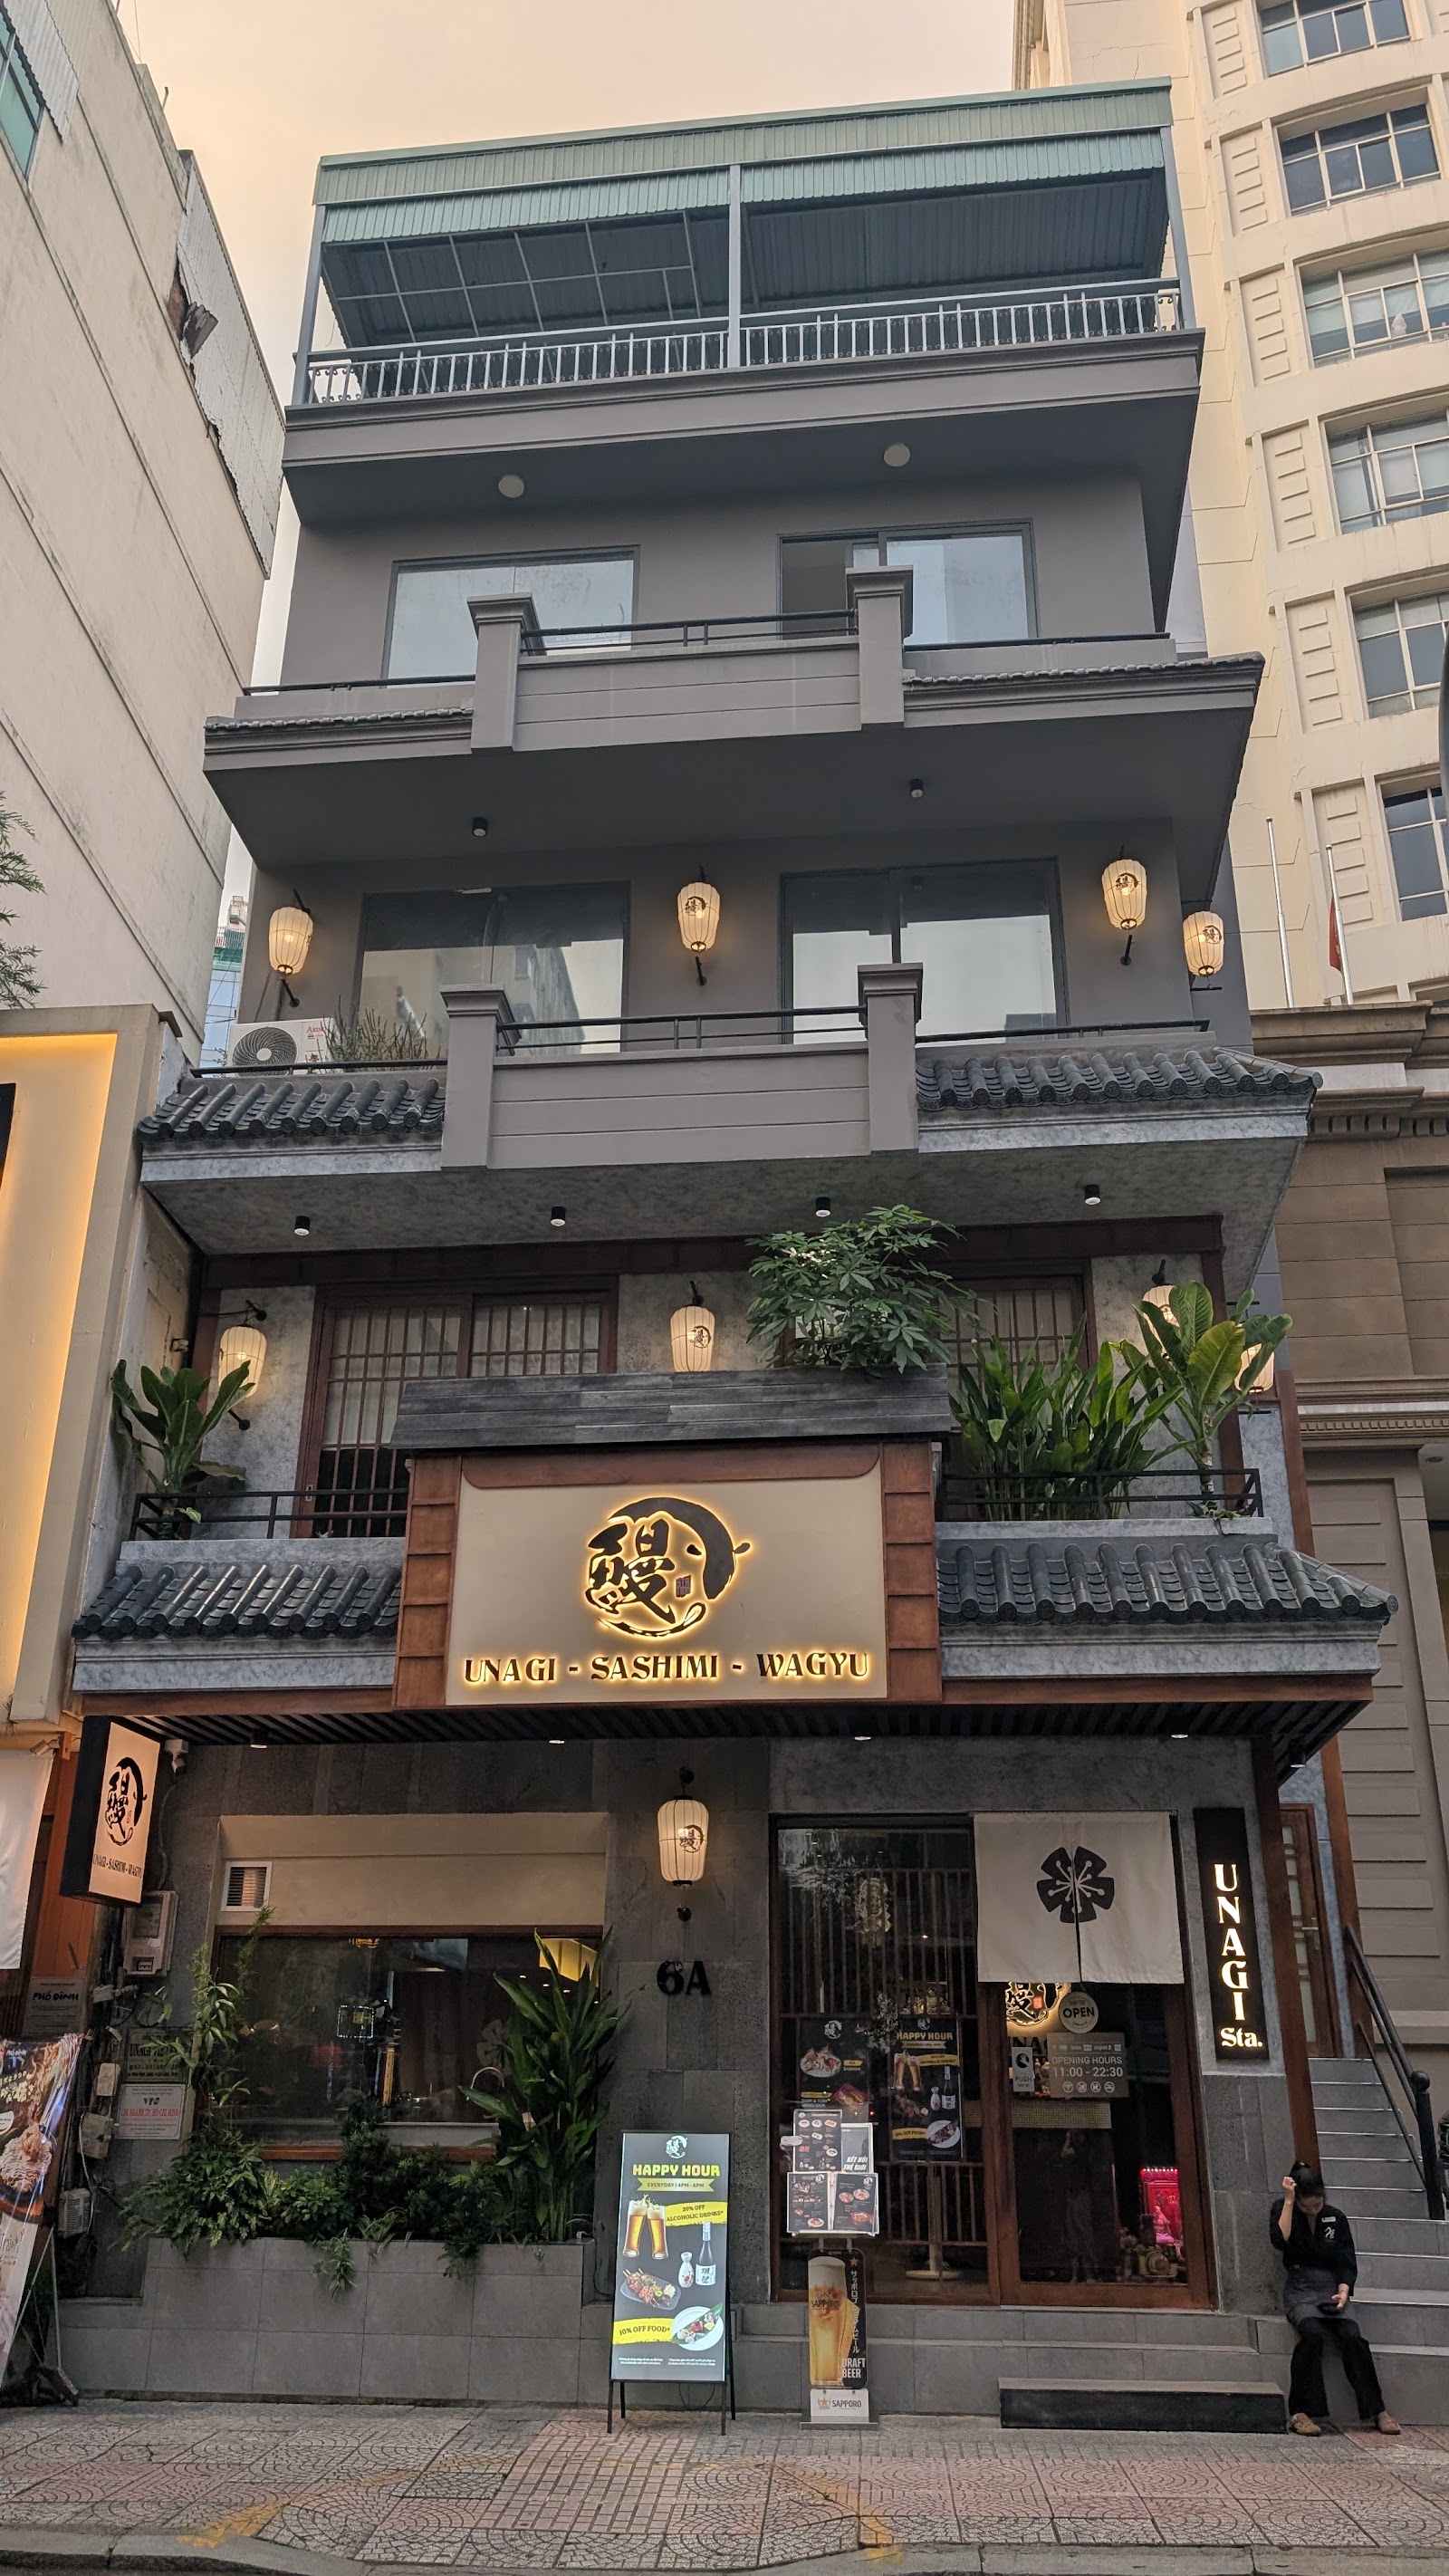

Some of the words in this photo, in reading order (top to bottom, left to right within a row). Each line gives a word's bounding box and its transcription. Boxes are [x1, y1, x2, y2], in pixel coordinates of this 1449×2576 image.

[465, 1657, 556, 1683] UNAGI
[590, 1654, 719, 1680] SASHIMI
[755, 1651, 868, 1677] WAGYU
[1214, 1863, 1249, 2021] UNAGI
[657, 1960, 712, 1995] 6A
[1062, 2007, 1095, 2019] OPEN
[897, 2032, 927, 2041] HAPPY
[927, 2032, 954, 2041] HOUR
[1221, 2027, 1263, 2048] Sta.
[1052, 2056, 1090, 2064] OPENING
[1092, 2056, 1123, 2064] HOURS
[1053, 2067, 1083, 2077] 11:00
[1092, 2067, 1123, 2077] 22:30
[632, 2164, 679, 2177] HAPPY
[681, 2164, 721, 2177] HOUR
[666, 2213, 699, 2223] ALCOHOLIC
[811, 2300, 840, 2308] SAPPORO
[619, 2327, 632, 2336] 10%
[632, 2325, 647, 2333] OFF
[842, 2357, 866, 2369] DRAFT
[842, 2368, 862, 2379] BEER
[831, 2399, 862, 2408] SAPPORO
